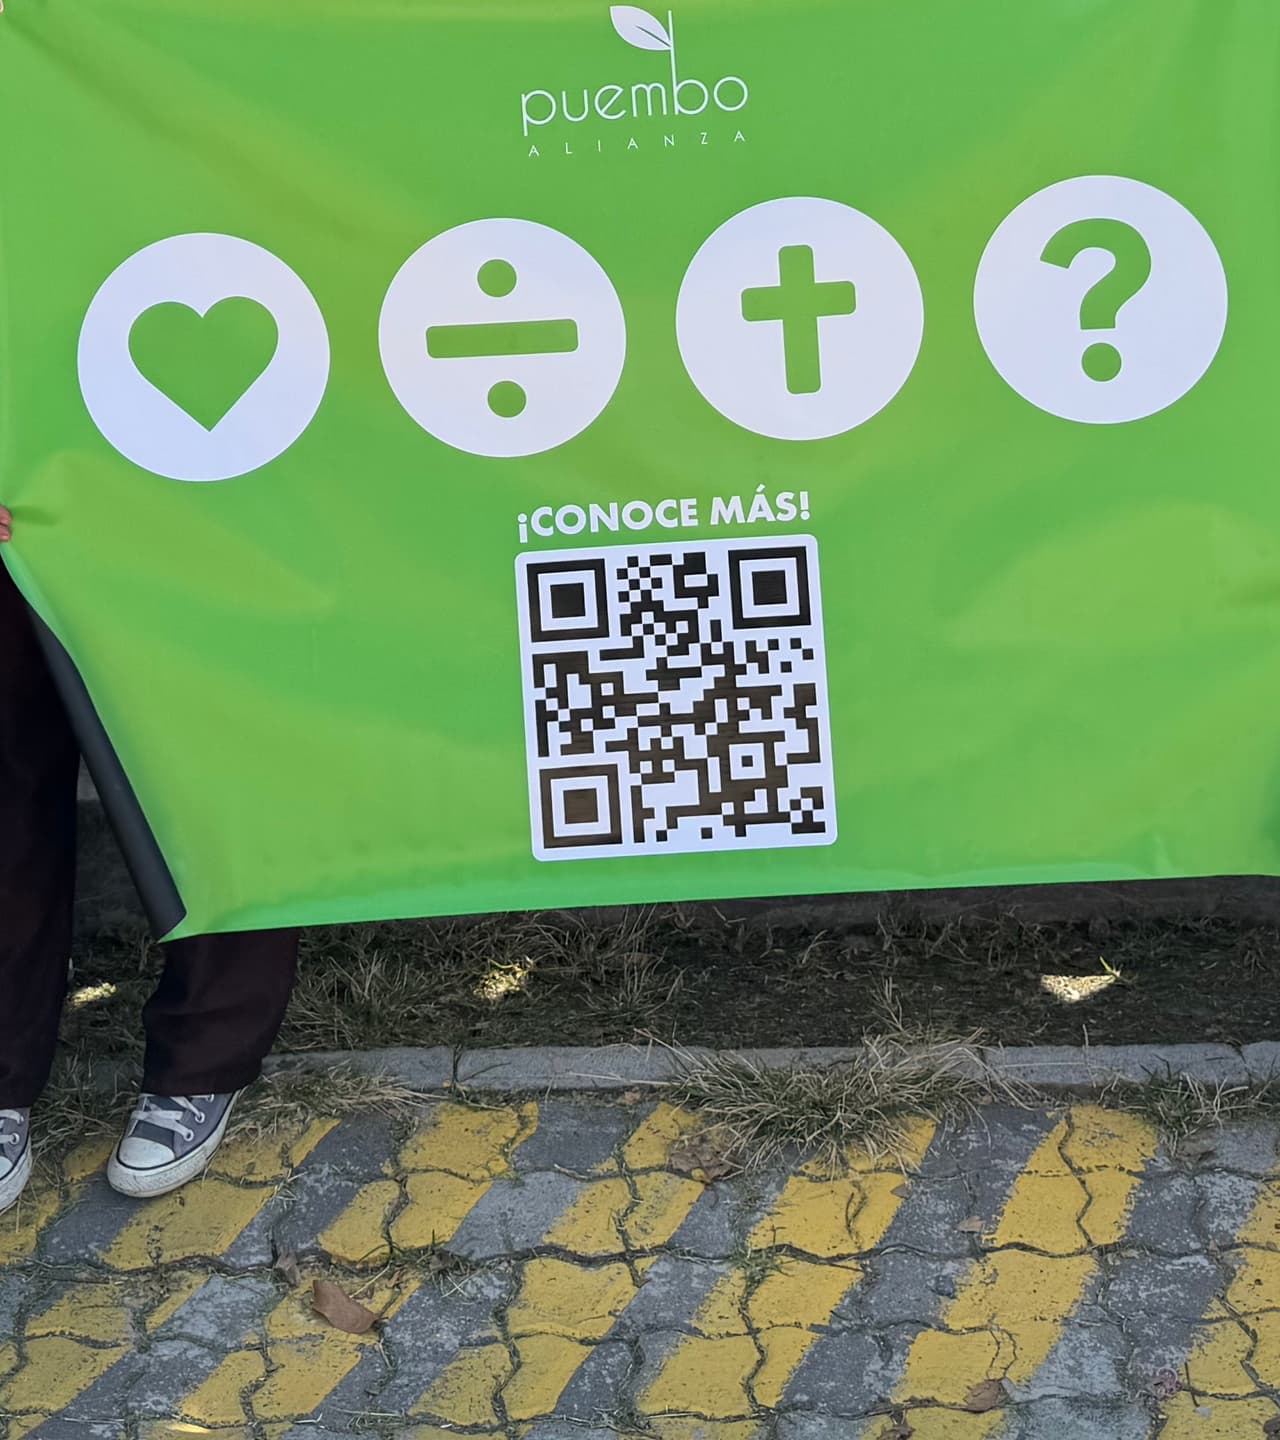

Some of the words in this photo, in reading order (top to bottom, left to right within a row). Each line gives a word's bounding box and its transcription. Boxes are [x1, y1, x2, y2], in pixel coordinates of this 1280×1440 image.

[521, 10, 748, 137] puembo
[528, 130, 746, 158] ALIANZA
[517, 497, 700, 544] ¡CONOCE
[709, 483, 811, 526] MÁS!
